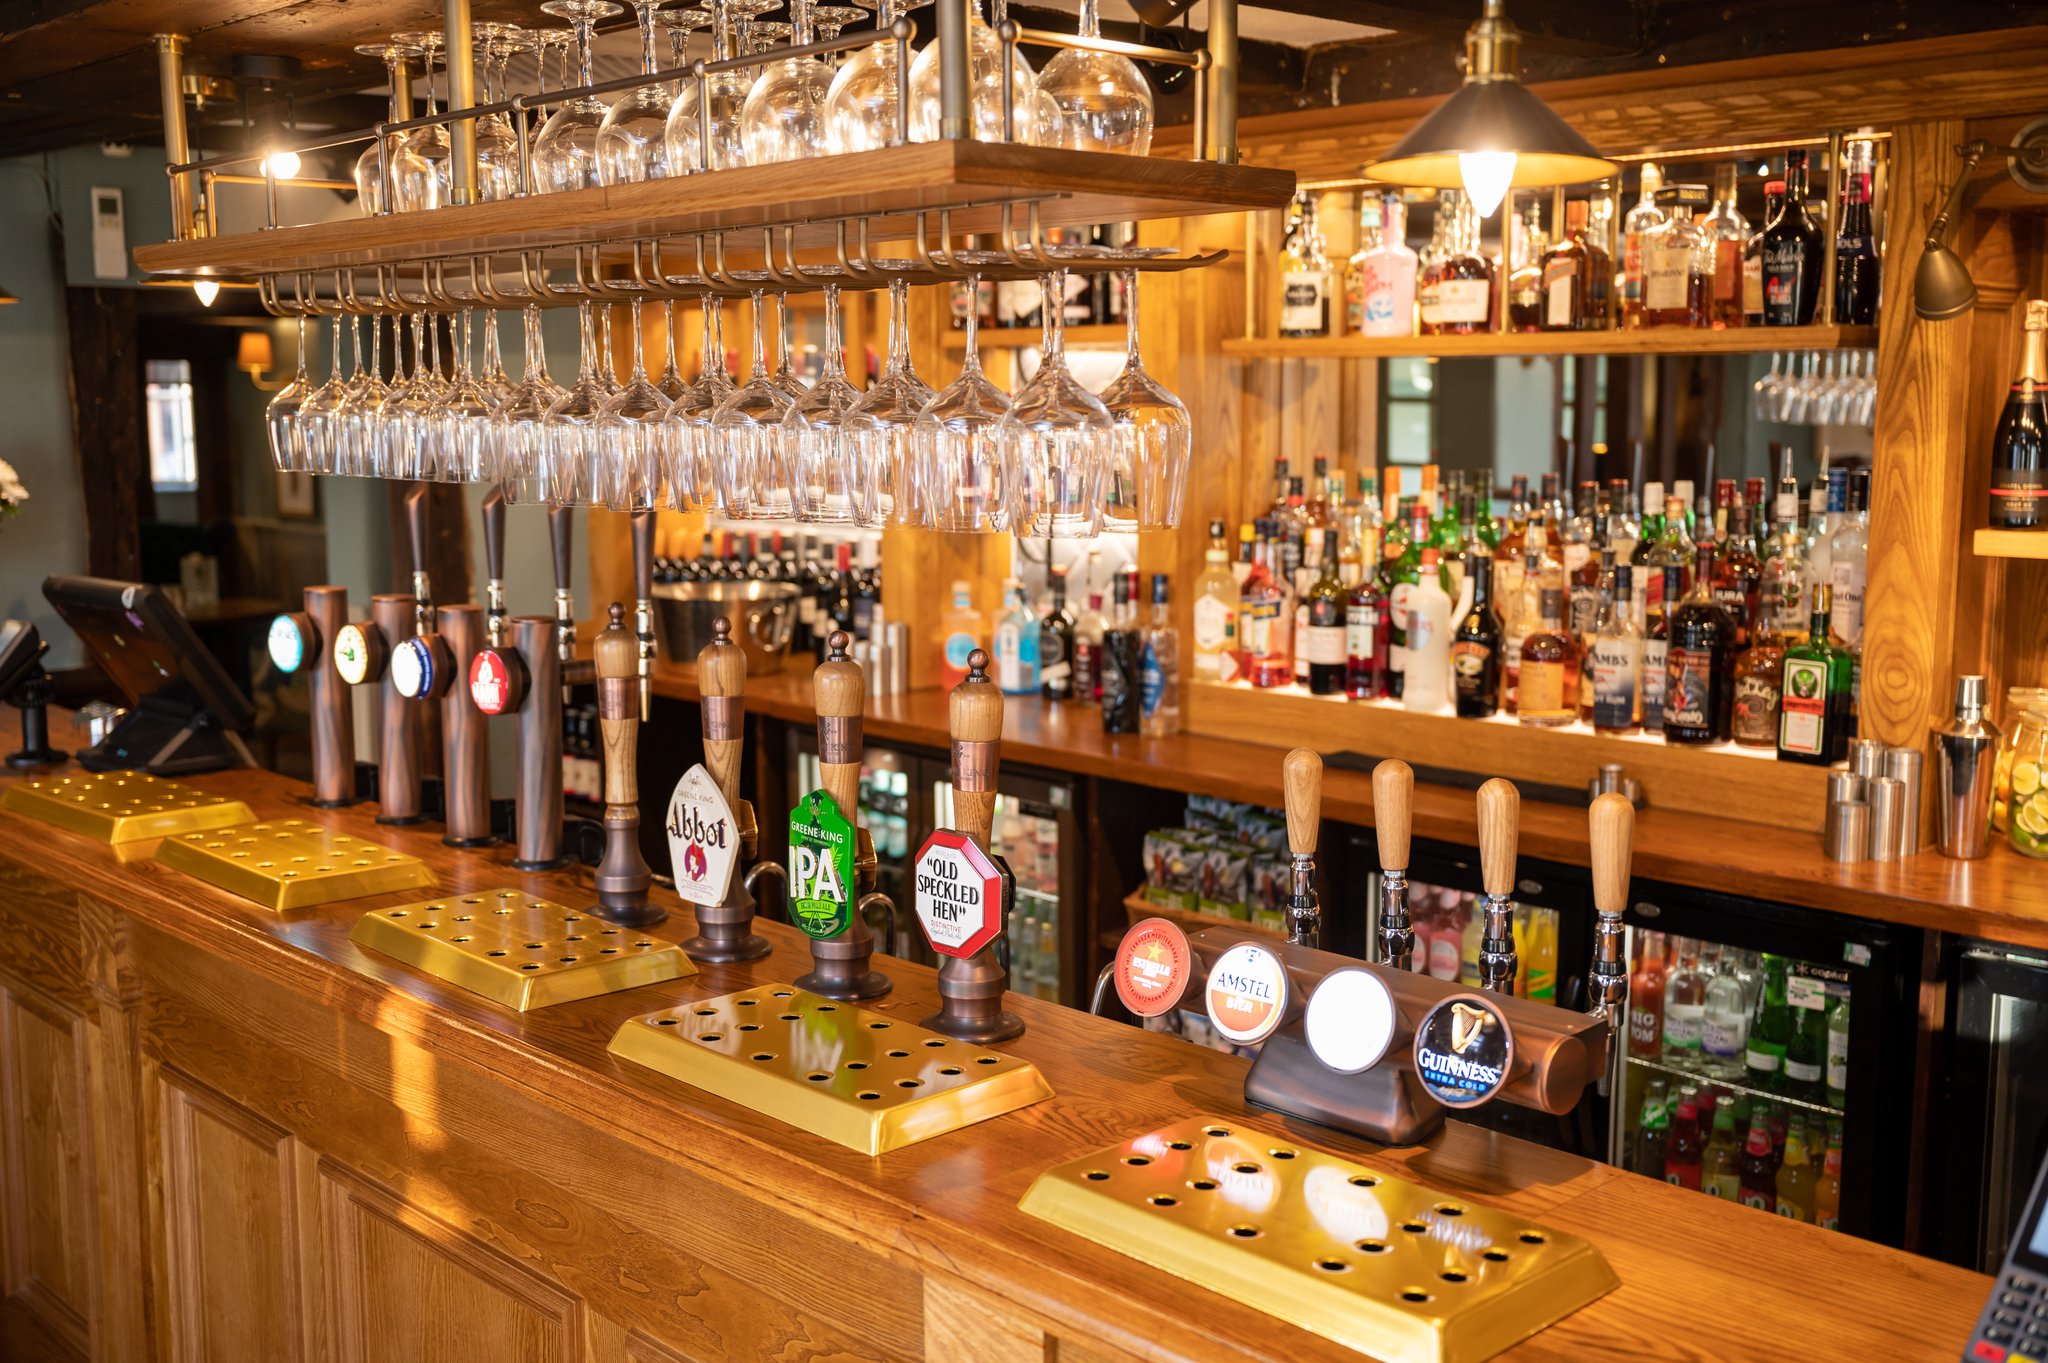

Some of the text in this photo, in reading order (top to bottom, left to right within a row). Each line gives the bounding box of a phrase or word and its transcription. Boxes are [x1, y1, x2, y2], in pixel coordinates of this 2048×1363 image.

[1836, 237, 1862, 249] OLS
[667, 800, 728, 849] Abbot
[791, 820, 818, 838] GREENE
[820, 828, 843, 844] KING
[789, 845, 845, 902] IPA
[918, 874, 979, 905] SPECKLED
[930, 919, 962, 933] DISTINCTIVE
[1217, 972, 1270, 998] AMSTEL
[1418, 1047, 1499, 1085] GUINNESS
[1424, 1070, 1456, 1086] EXTRA
[1458, 1079, 1487, 1092] COLD
